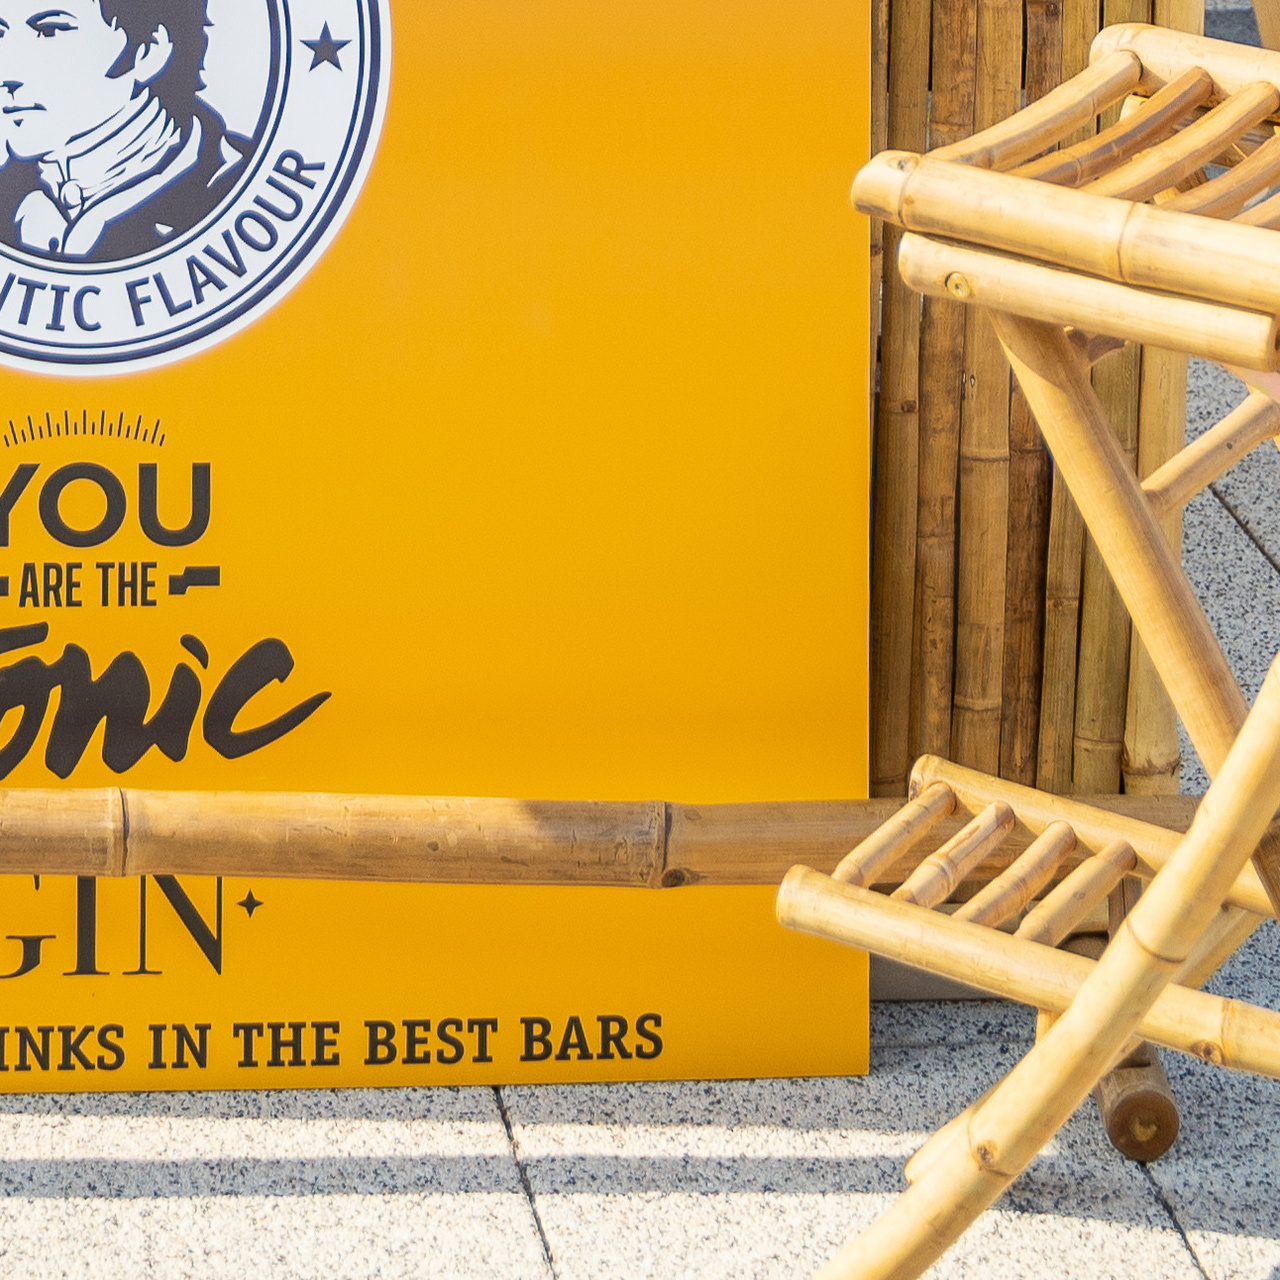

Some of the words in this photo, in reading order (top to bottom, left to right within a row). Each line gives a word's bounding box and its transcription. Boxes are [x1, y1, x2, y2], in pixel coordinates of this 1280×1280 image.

[124, 148, 326, 327] FLAVOUR
[18, 561, 82, 608] ARE
[95, 561, 158, 607] THE
[147, 1023, 211, 1070] IN
[233, 1022, 341, 1068] THE
[364, 1017, 498, 1066] BEST
[520, 1013, 663, 1063] BARS
